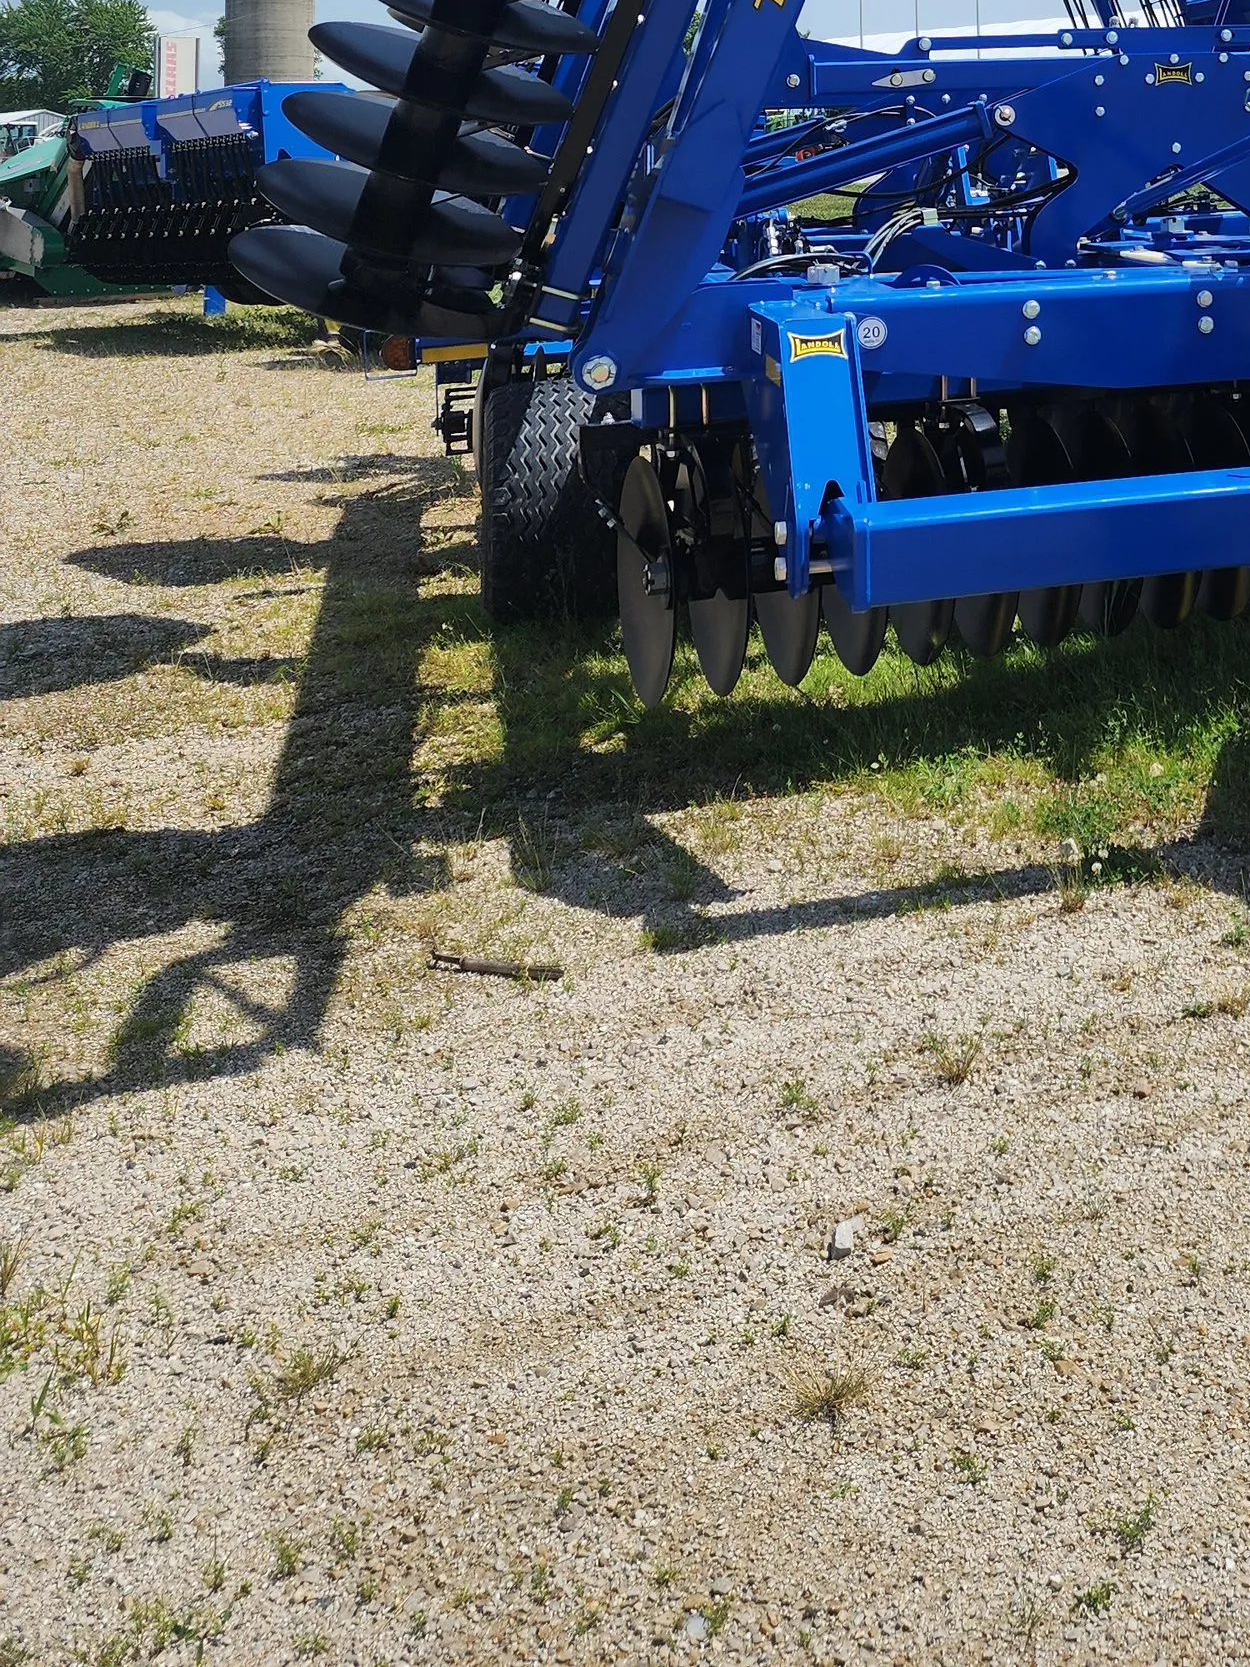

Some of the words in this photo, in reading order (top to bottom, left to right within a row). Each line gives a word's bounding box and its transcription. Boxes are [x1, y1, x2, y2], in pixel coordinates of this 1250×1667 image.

[166, 41, 176, 95] CLAAS
[1159, 67, 1188, 80] LANDOLL
[863, 326, 880, 338] 20
[795, 338, 842, 356] LANDOLL
